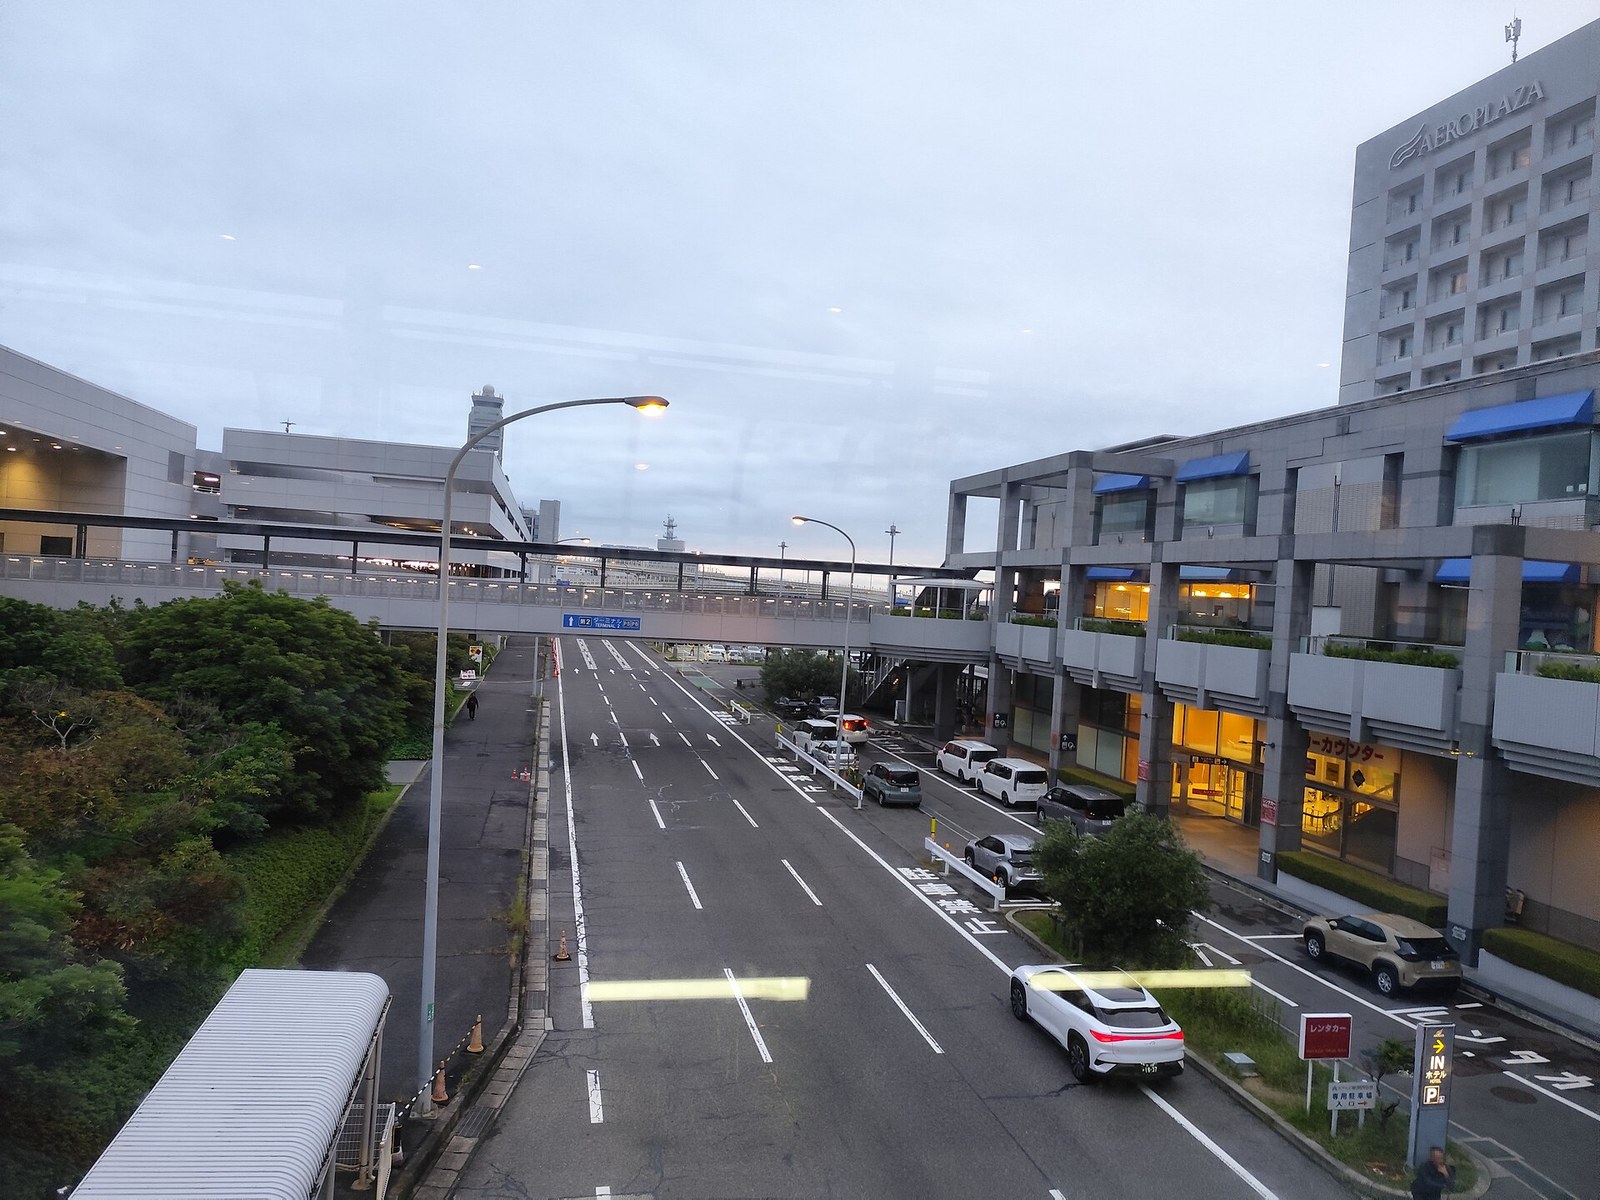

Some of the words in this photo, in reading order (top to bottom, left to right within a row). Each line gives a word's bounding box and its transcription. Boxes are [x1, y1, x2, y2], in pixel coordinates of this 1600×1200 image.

[1418, 79, 1545, 157] AEROPLAZA
[897, 867, 1009, 935] 駐車禁止
[1310, 1024, 1347, 1033] レンタカー
[1430, 1055, 1445, 1070] IN
[1425, 1070, 1447, 1079] ホテル
[1332, 1091, 1373, 1100] 専用駐車場
[1426, 1088, 1437, 1103] P
